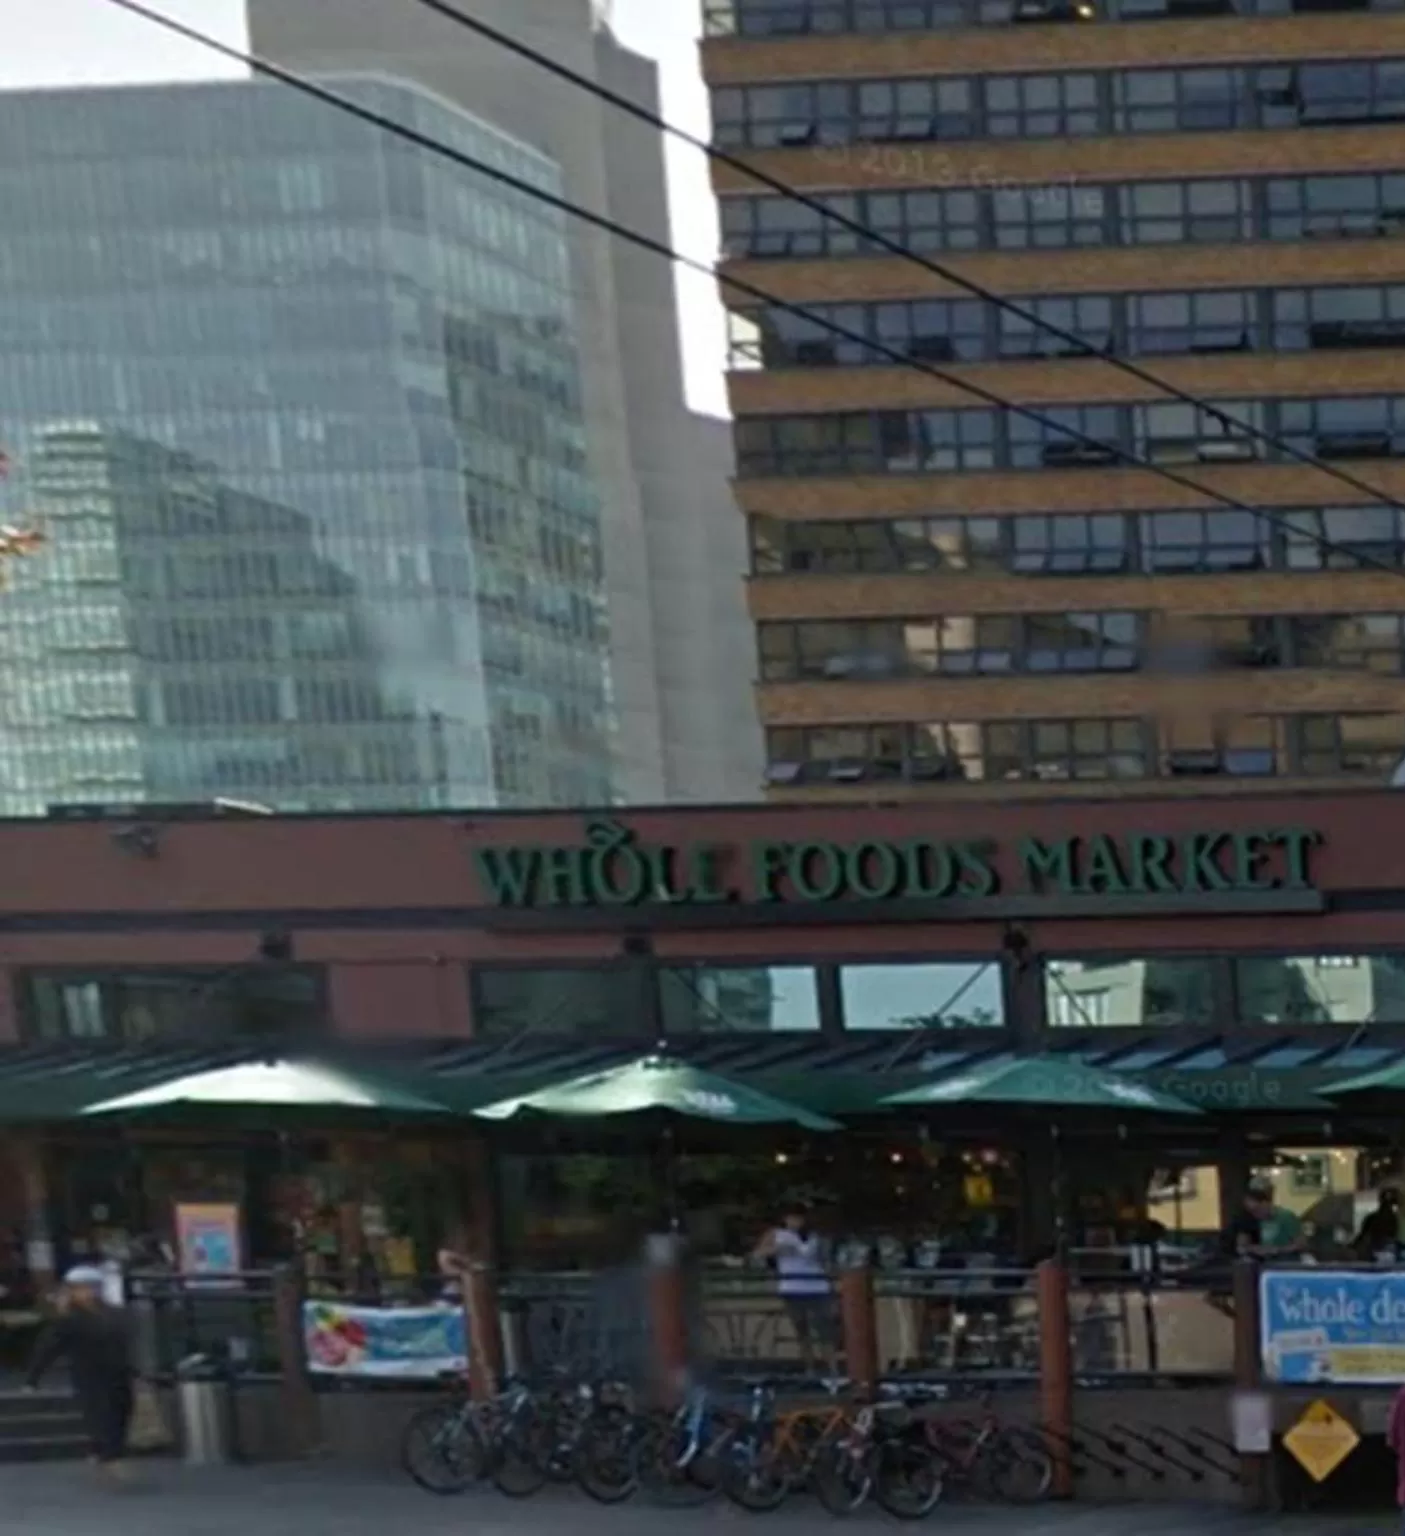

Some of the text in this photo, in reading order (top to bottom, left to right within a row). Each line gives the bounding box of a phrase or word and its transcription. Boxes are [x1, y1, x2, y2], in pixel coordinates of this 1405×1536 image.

[474, 820, 1326, 905] WHOLE FOODS MARKET
[1277, 1287, 1365, 1325] whole
